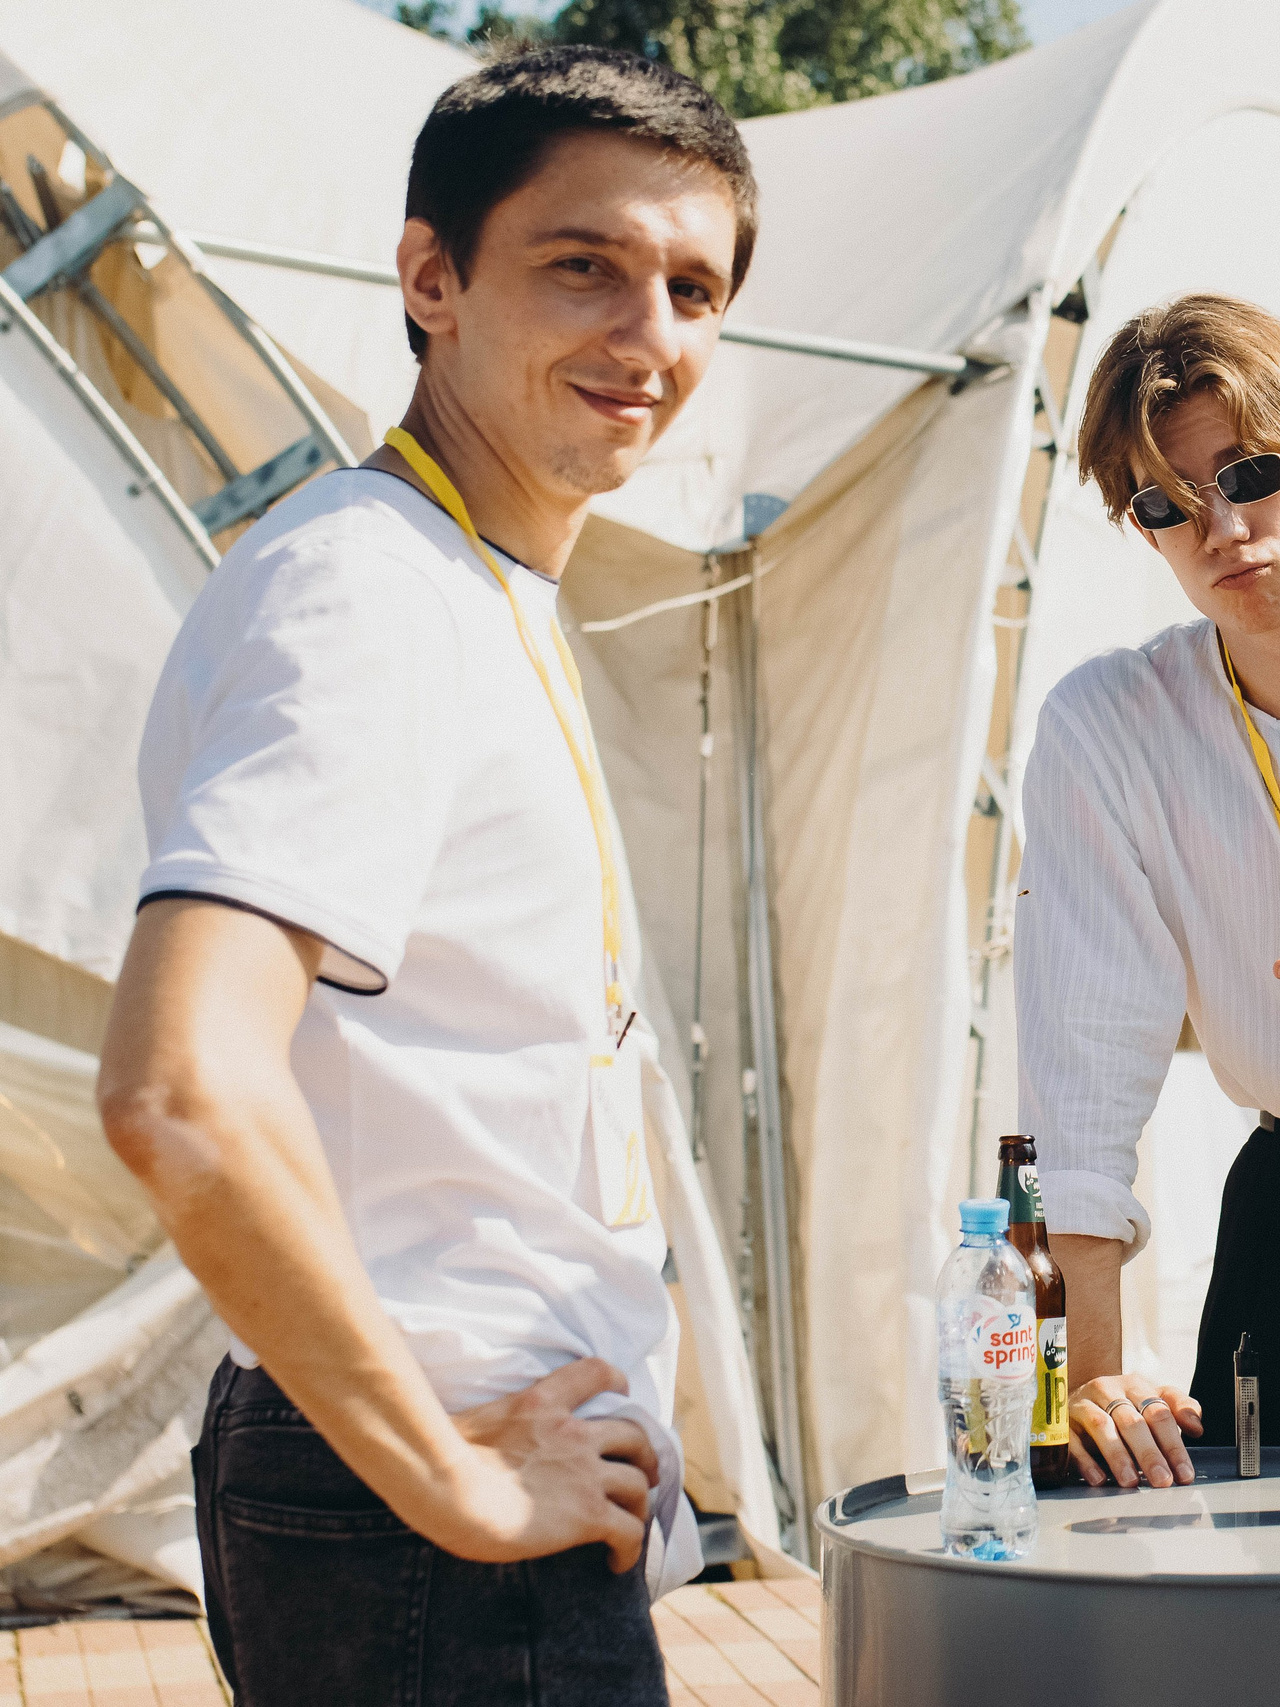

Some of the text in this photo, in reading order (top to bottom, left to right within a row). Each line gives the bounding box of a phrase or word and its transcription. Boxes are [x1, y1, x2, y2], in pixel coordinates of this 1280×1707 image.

[990, 1325, 1033, 1347] saint
[983, 1344, 1036, 1369] spring
[1045, 1372, 1069, 1425] IP
